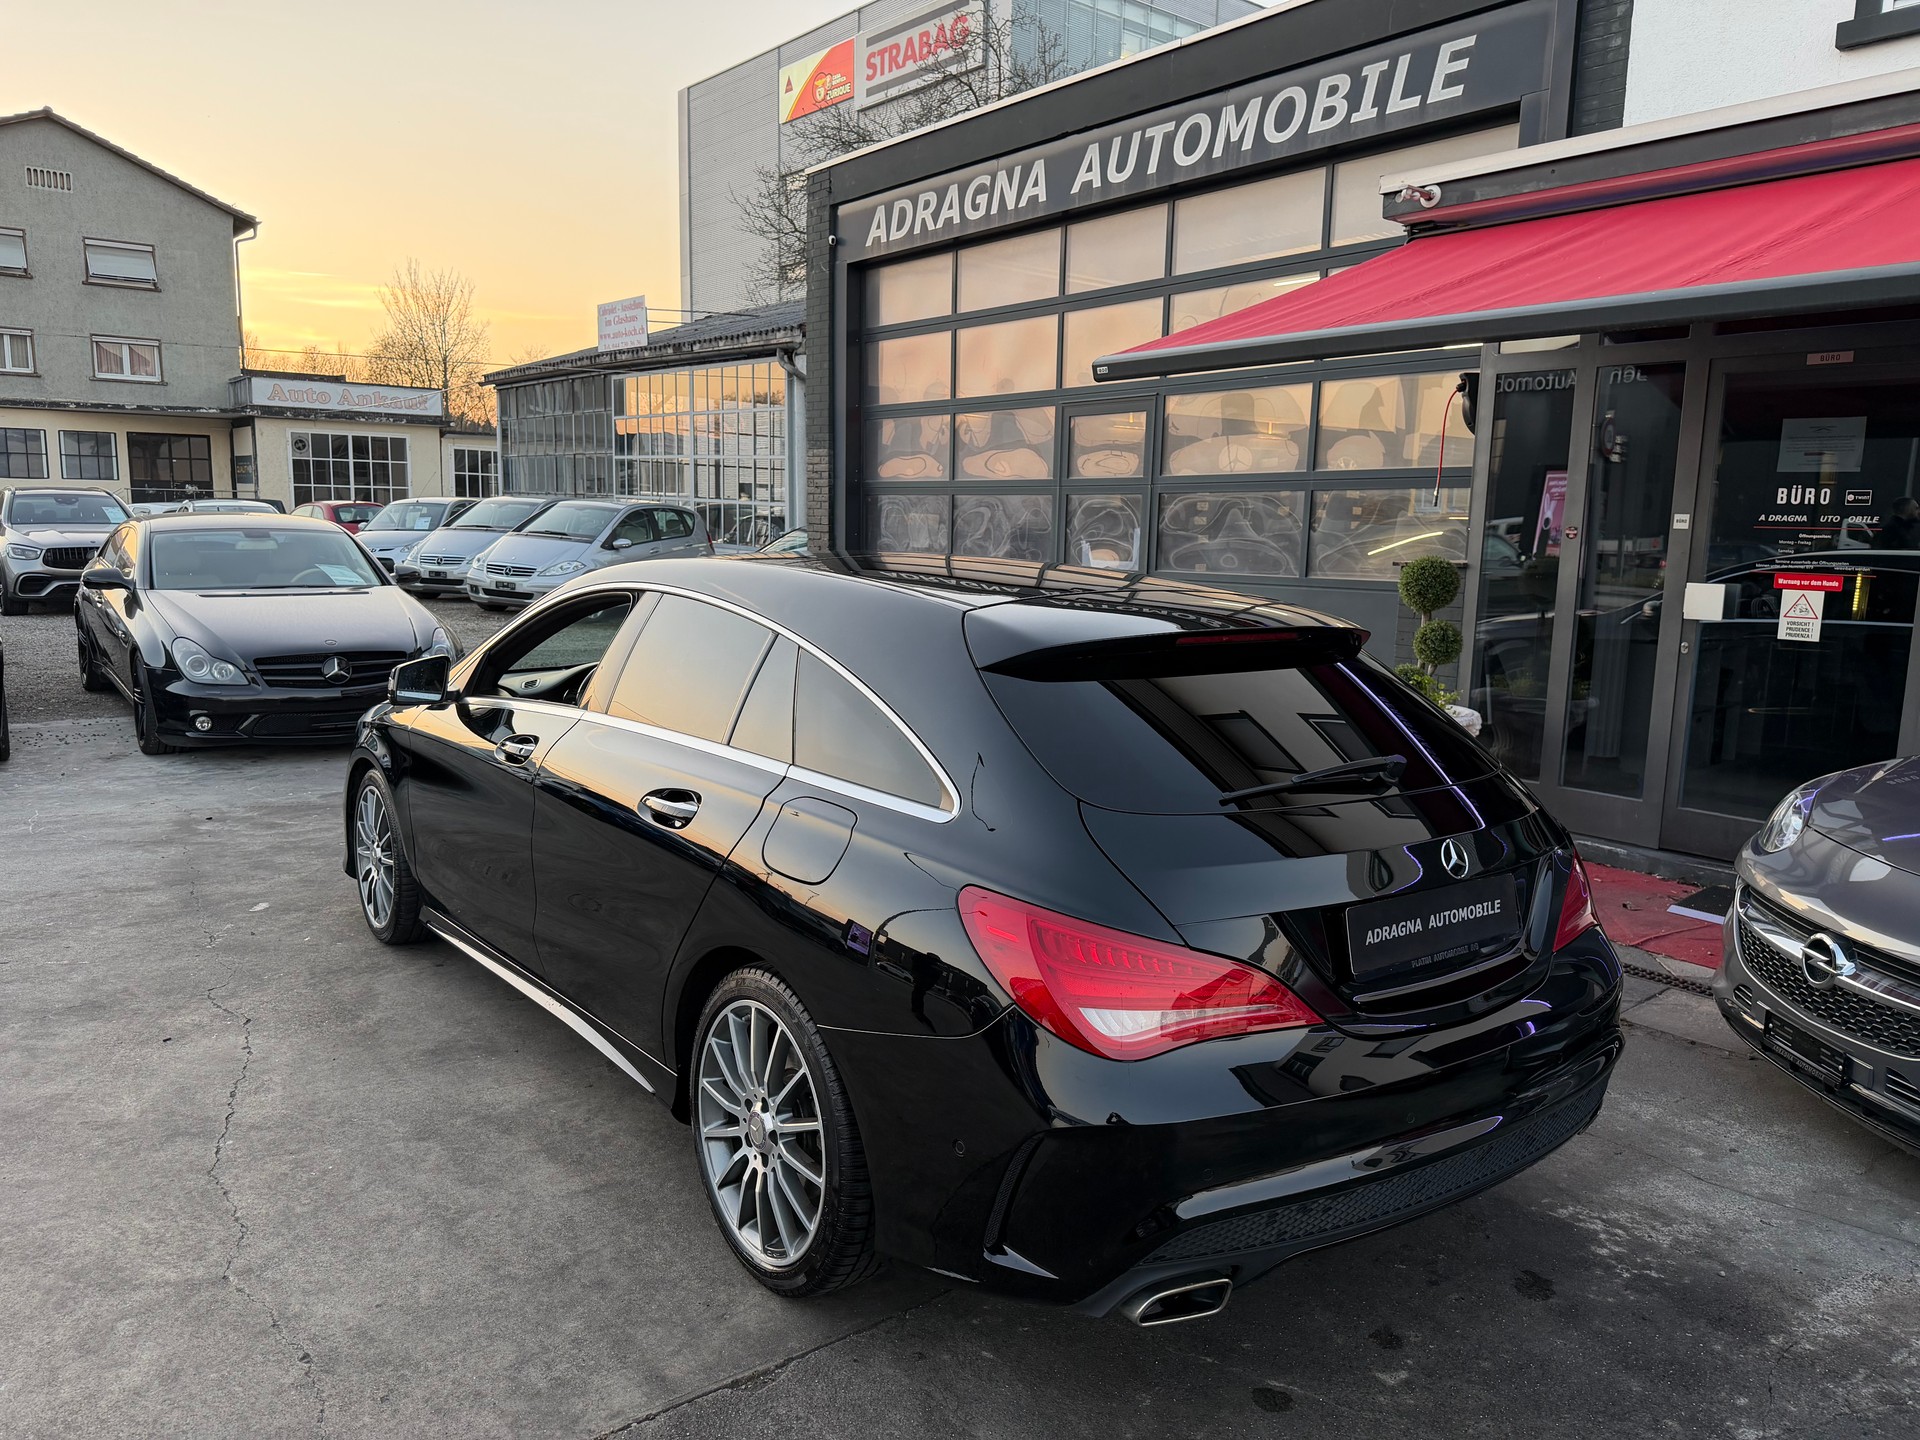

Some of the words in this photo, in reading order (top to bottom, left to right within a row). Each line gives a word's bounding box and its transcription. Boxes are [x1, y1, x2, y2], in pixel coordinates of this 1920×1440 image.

[865, 15, 969, 81] STRABAG
[865, 158, 1047, 248] ADRAGNA
[1071, 34, 1478, 194] AUTOMOBILE
[613, 313, 638, 326] Glashaus
[1820, 353, 1841, 362] BÜRO
[267, 384, 331, 405] Auto
[337, 389, 429, 411] Ankauf
[1776, 484, 1831, 505] BÜRO
[1778, 578, 1800, 586] Warnung
[1365, 918, 1423, 946] ADRAGNA
[1428, 899, 1501, 929] AUTOMOBILE
[1433, 945, 1469, 962] AUTOMOBILE
